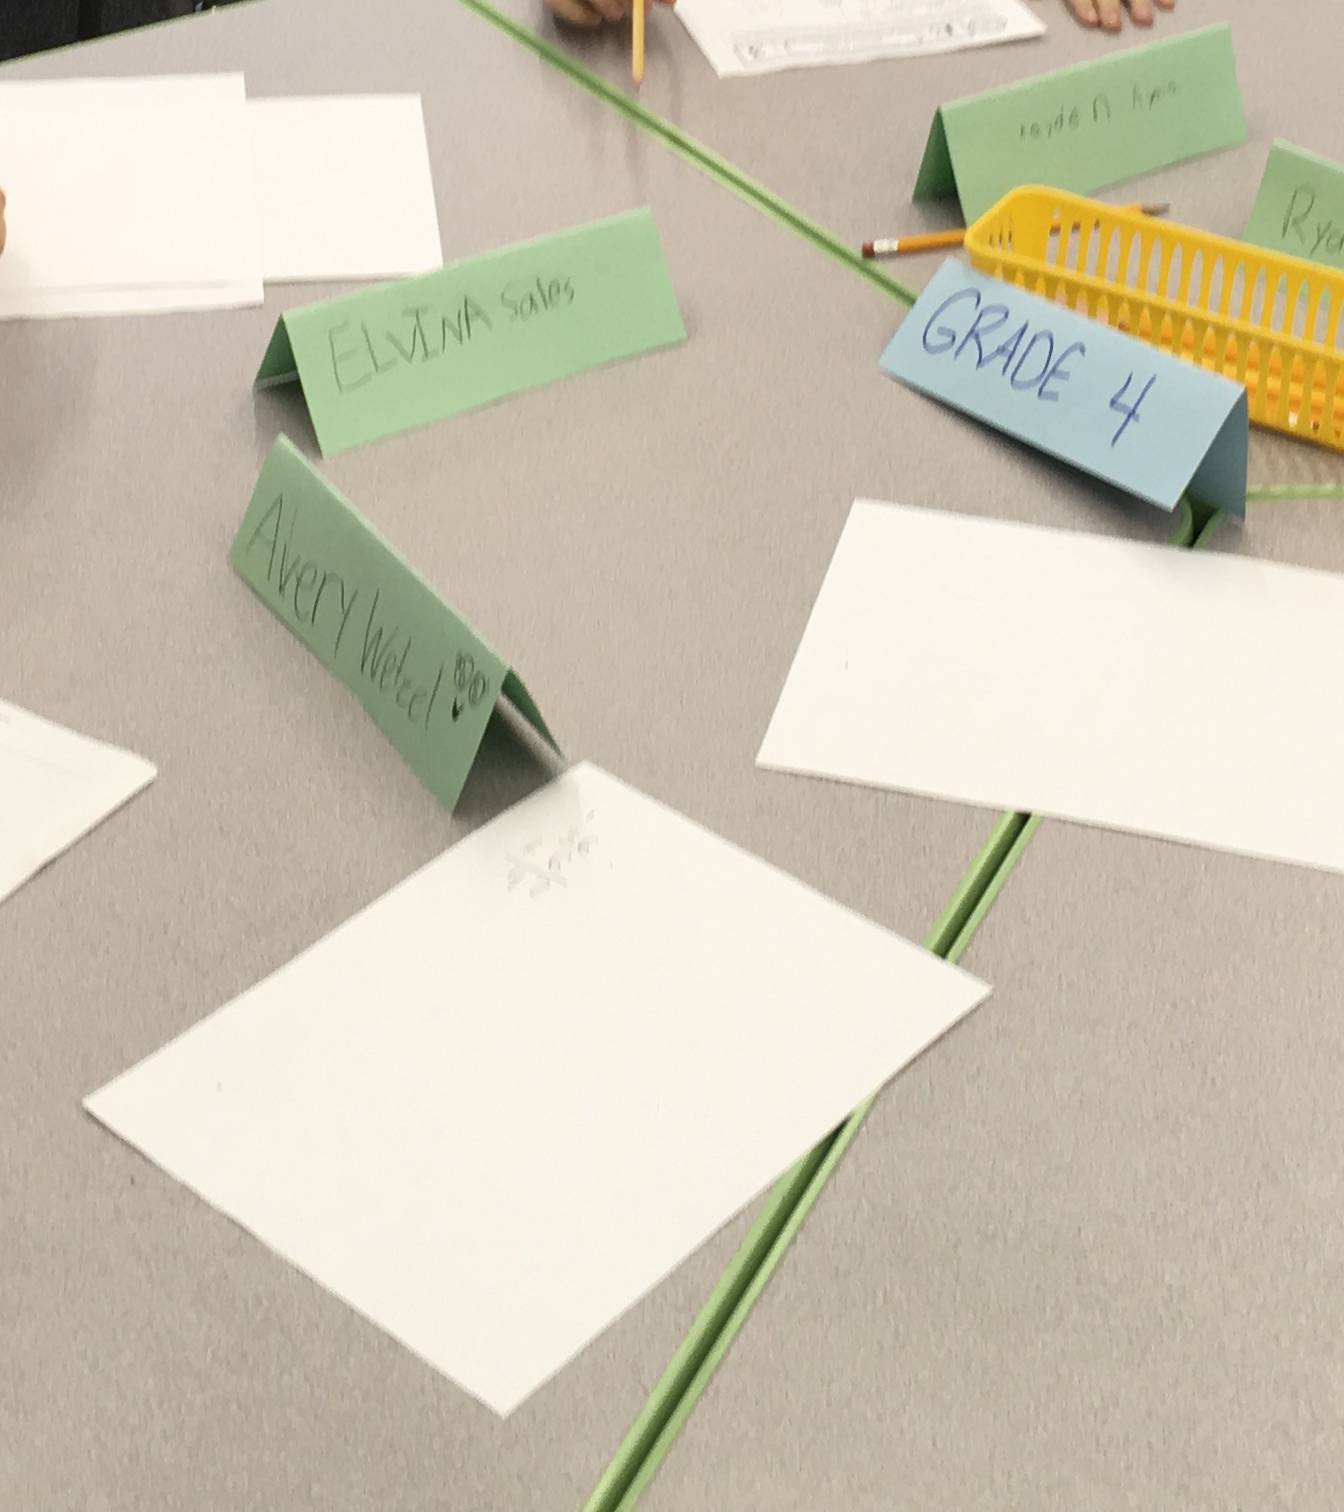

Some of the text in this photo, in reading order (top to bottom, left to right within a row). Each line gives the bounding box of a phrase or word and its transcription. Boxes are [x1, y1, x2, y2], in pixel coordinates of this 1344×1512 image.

[327, 294, 494, 393] ELVINA
[921, 286, 1158, 447] GRADE 4
[245, 492, 358, 659] Avery
